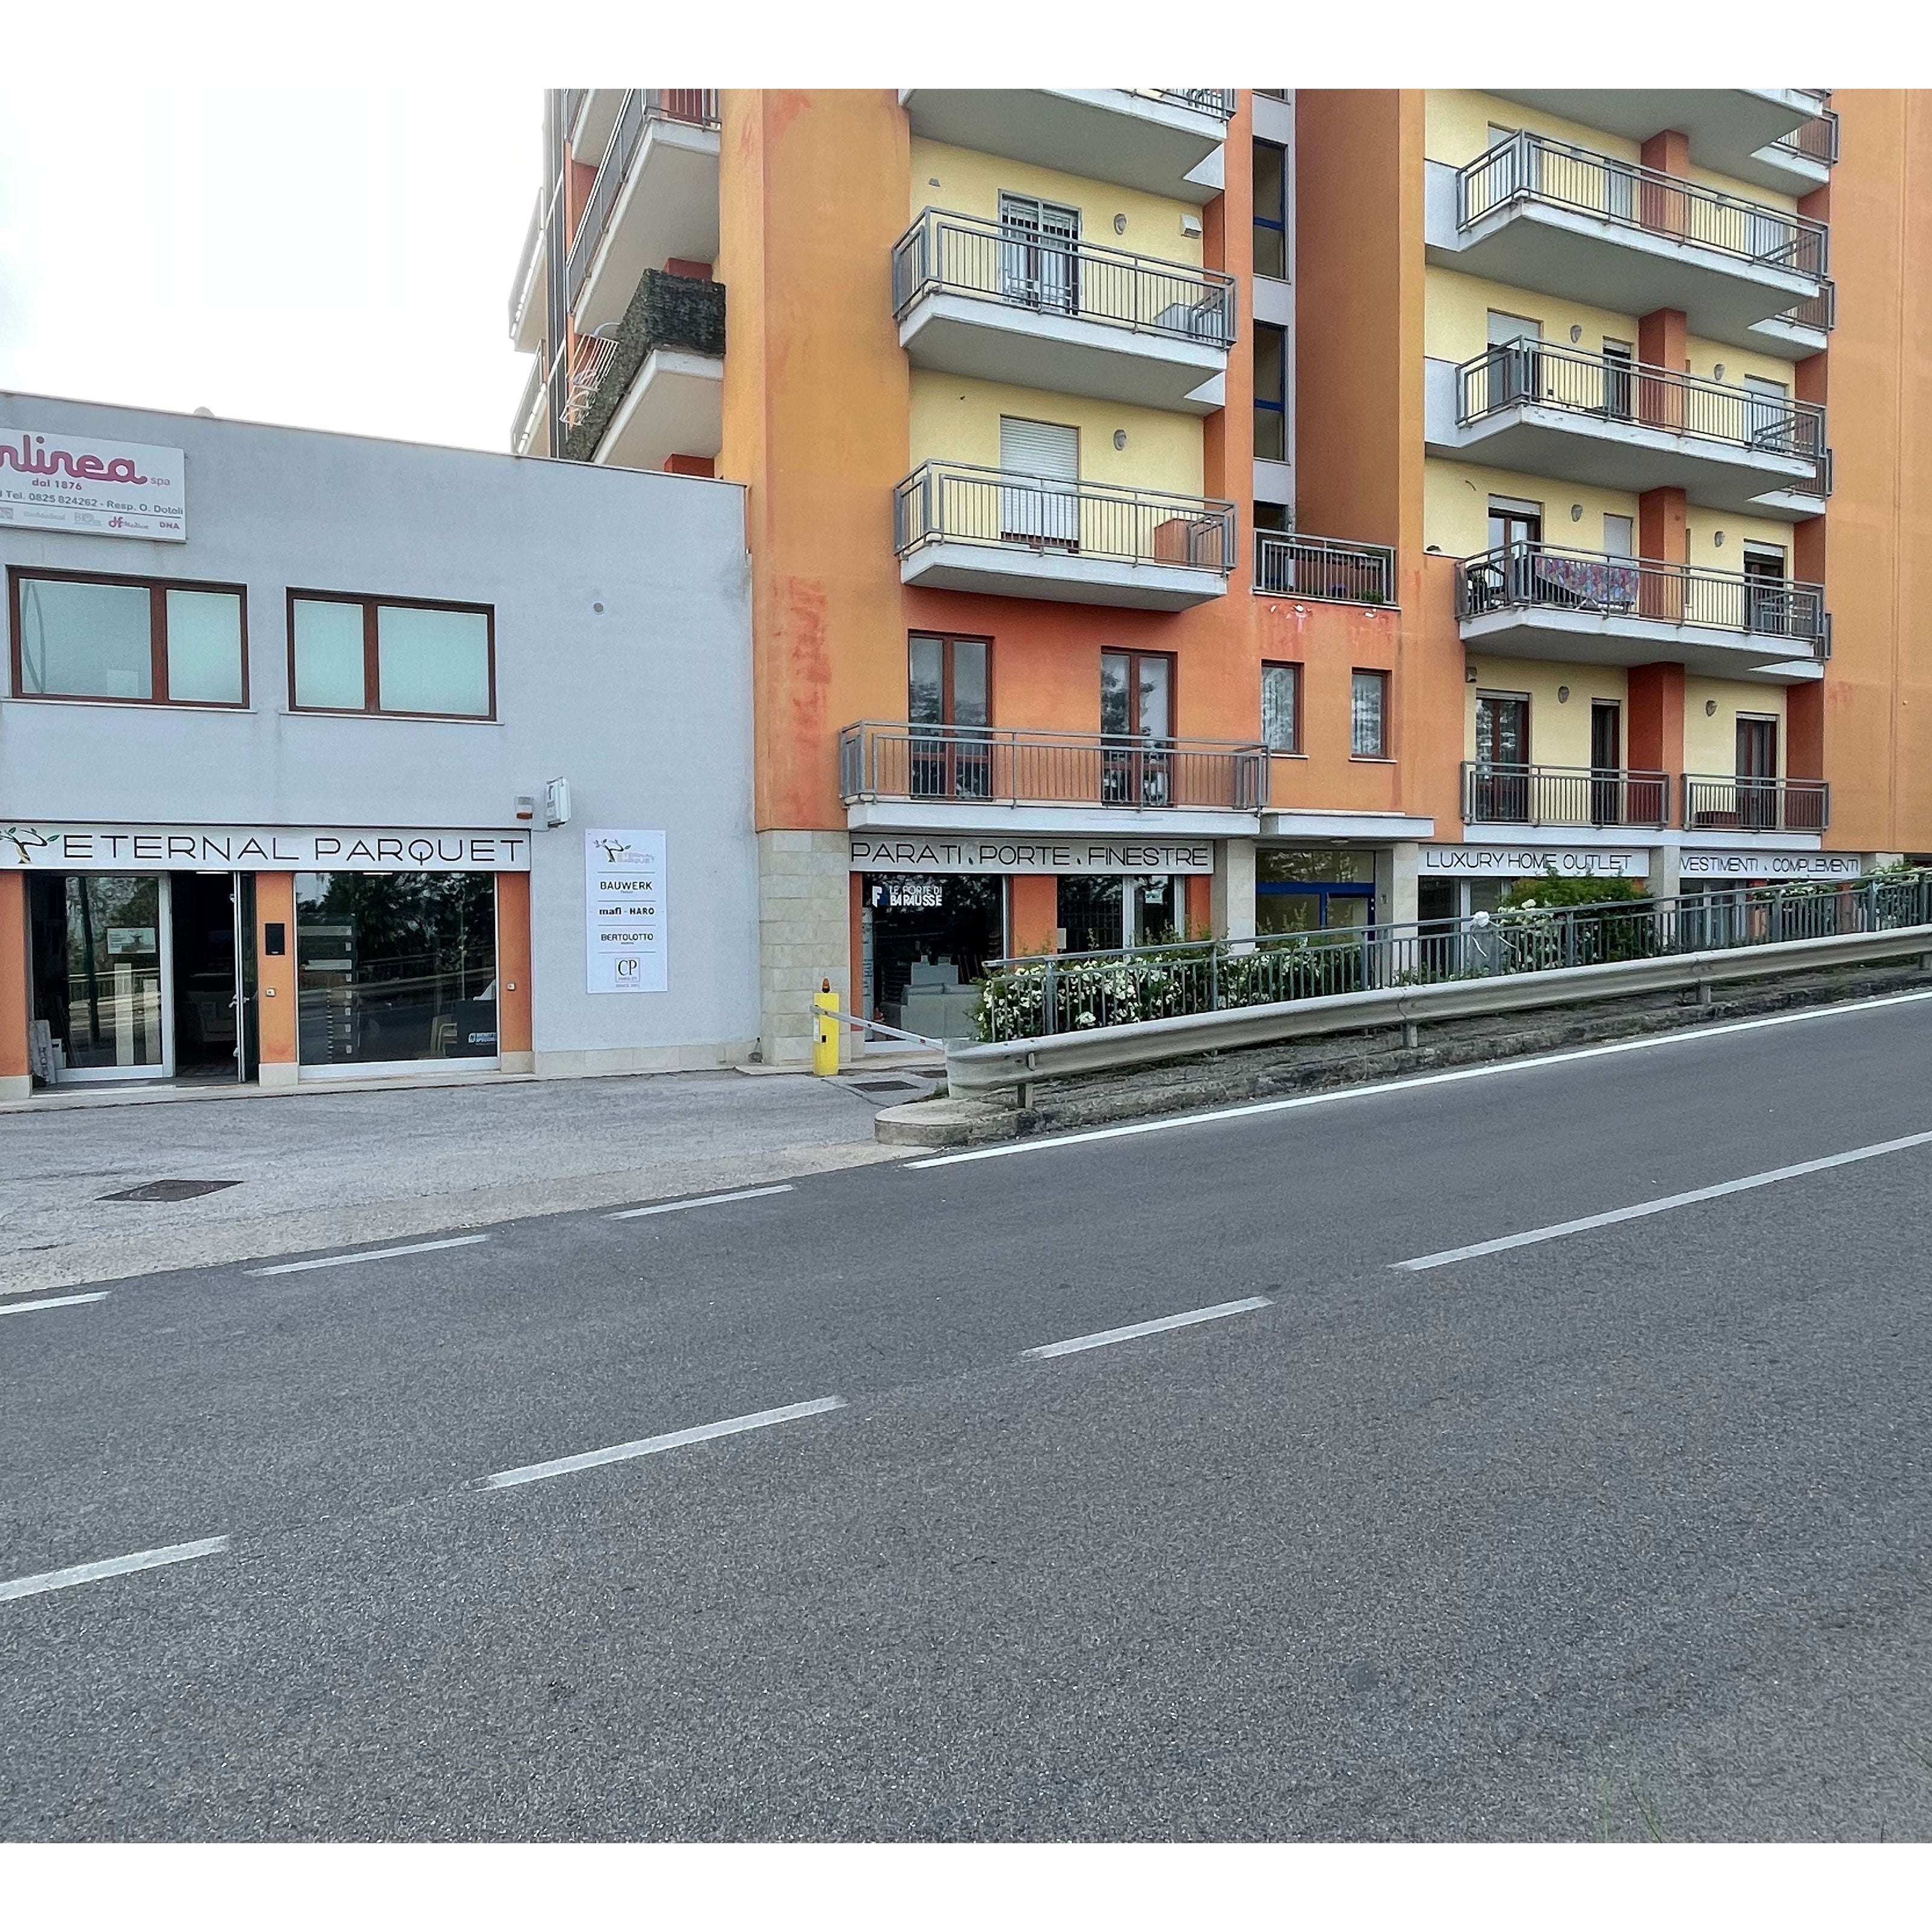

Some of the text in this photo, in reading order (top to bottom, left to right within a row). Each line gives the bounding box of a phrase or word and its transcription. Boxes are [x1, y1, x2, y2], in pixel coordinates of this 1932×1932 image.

[32, 478, 82, 490] dal 1876
[150, 477, 171, 487] spa
[28, 492, 56, 503] 0825
[58, 495, 97, 507] 824262
[159, 521, 180, 530] DNA
[63, 834, 525, 866] ETERNAL PARQUET
[850, 842, 1209, 867] PARATI PORTE FINESTRE
[1426, 851, 1633, 870] LUXURY HOME OUTLET
[1680, 856, 1860, 873] VESTIMENTI COMPLEMENTI
[600, 881, 653, 891] BAUWERK
[889, 885, 942, 895] LE PORTE DI
[889, 894, 942, 906] BARAUSSE
[629, 907, 655, 915] HARO
[601, 933, 654, 941] BERTOLOTTO
[618, 959, 638, 976] CP
